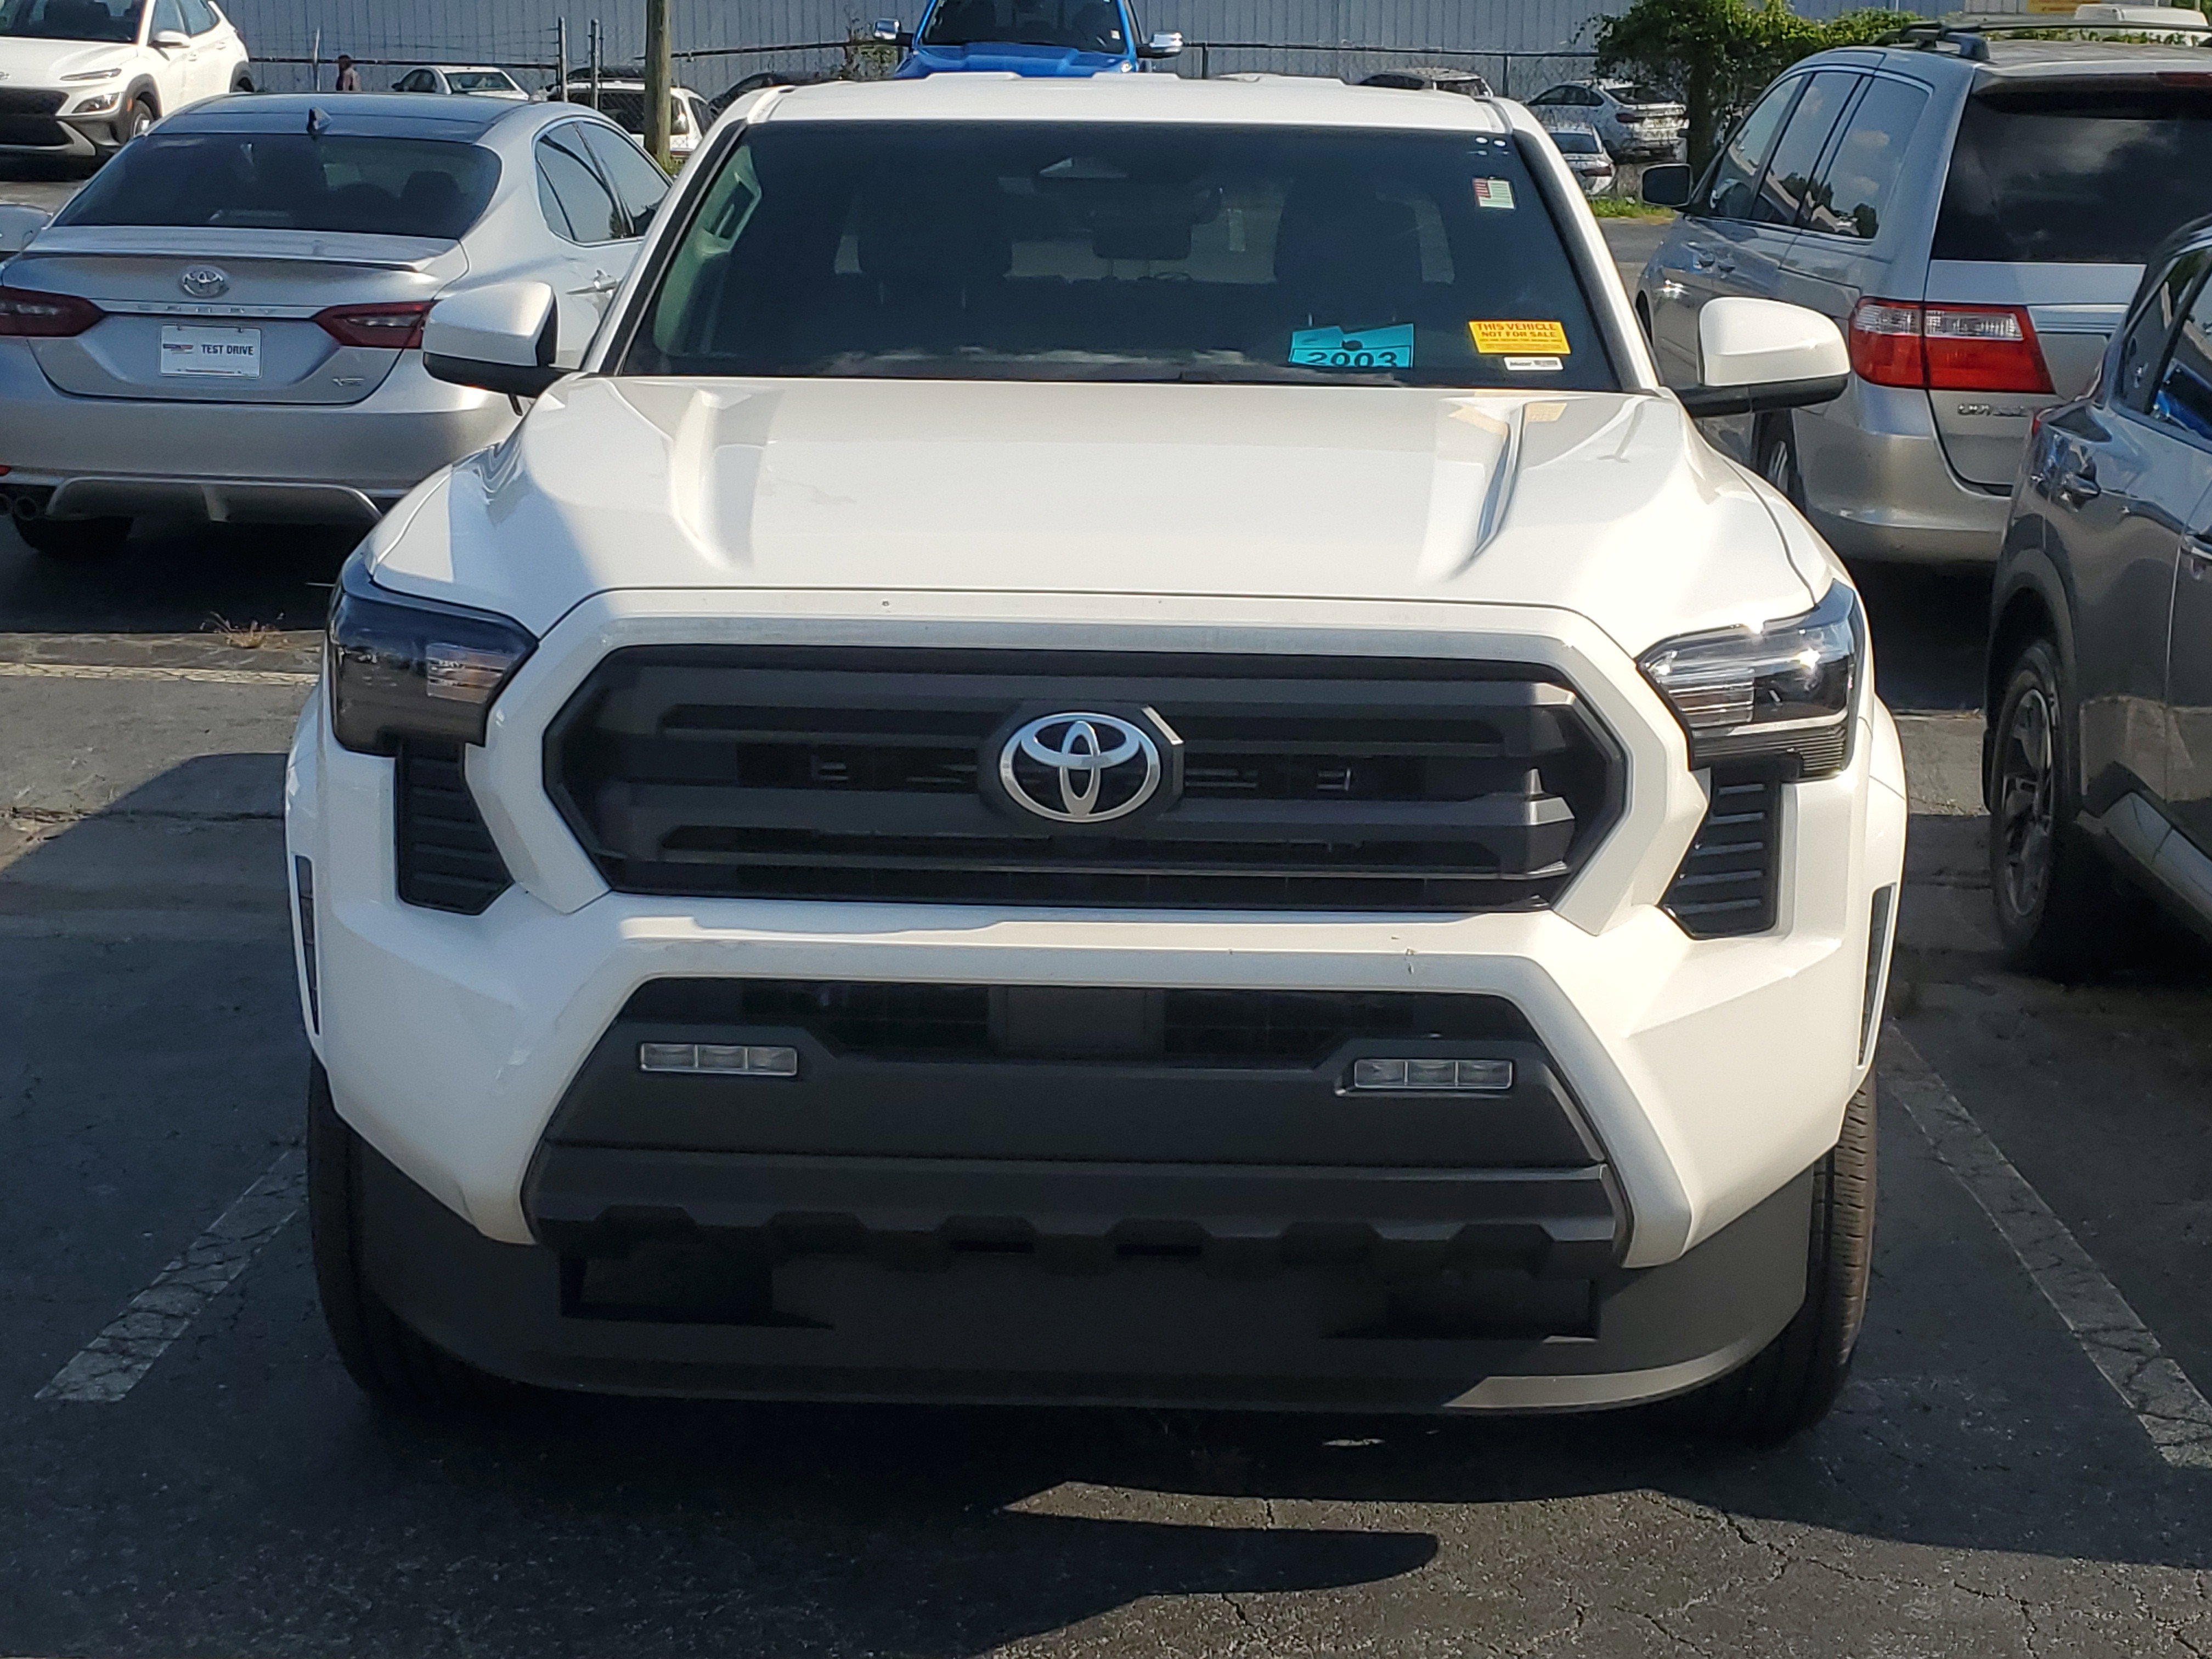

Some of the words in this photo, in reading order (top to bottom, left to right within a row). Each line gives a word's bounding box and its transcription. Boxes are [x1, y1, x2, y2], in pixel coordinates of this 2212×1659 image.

[201, 344, 223, 354] TEST
[227, 345, 253, 355] DRIVE
[1306, 352, 1397, 367] 2003
